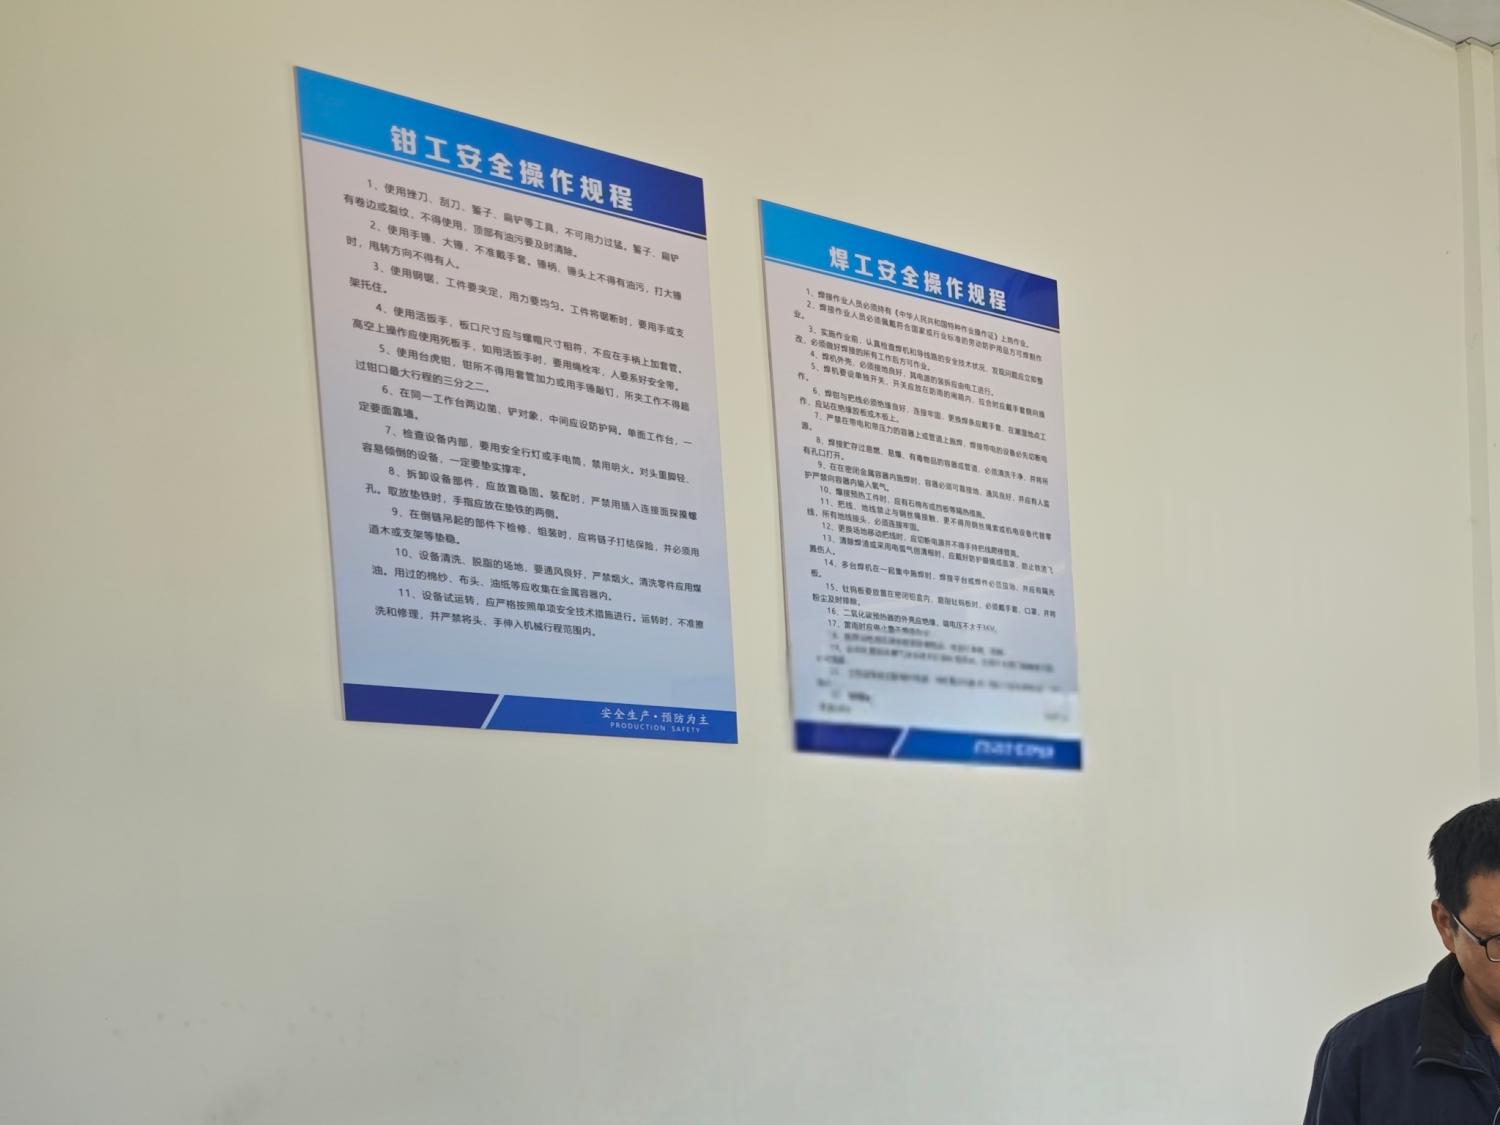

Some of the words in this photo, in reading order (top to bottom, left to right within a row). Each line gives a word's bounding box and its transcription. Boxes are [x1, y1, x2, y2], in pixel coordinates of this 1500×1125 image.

[389, 122, 635, 213] 钳工安全操作规程
[828, 244, 1008, 313] 焊工安全操作规程
[610, 721, 666, 732] PRODUCTION
[671, 725, 701, 734] SAFETY
